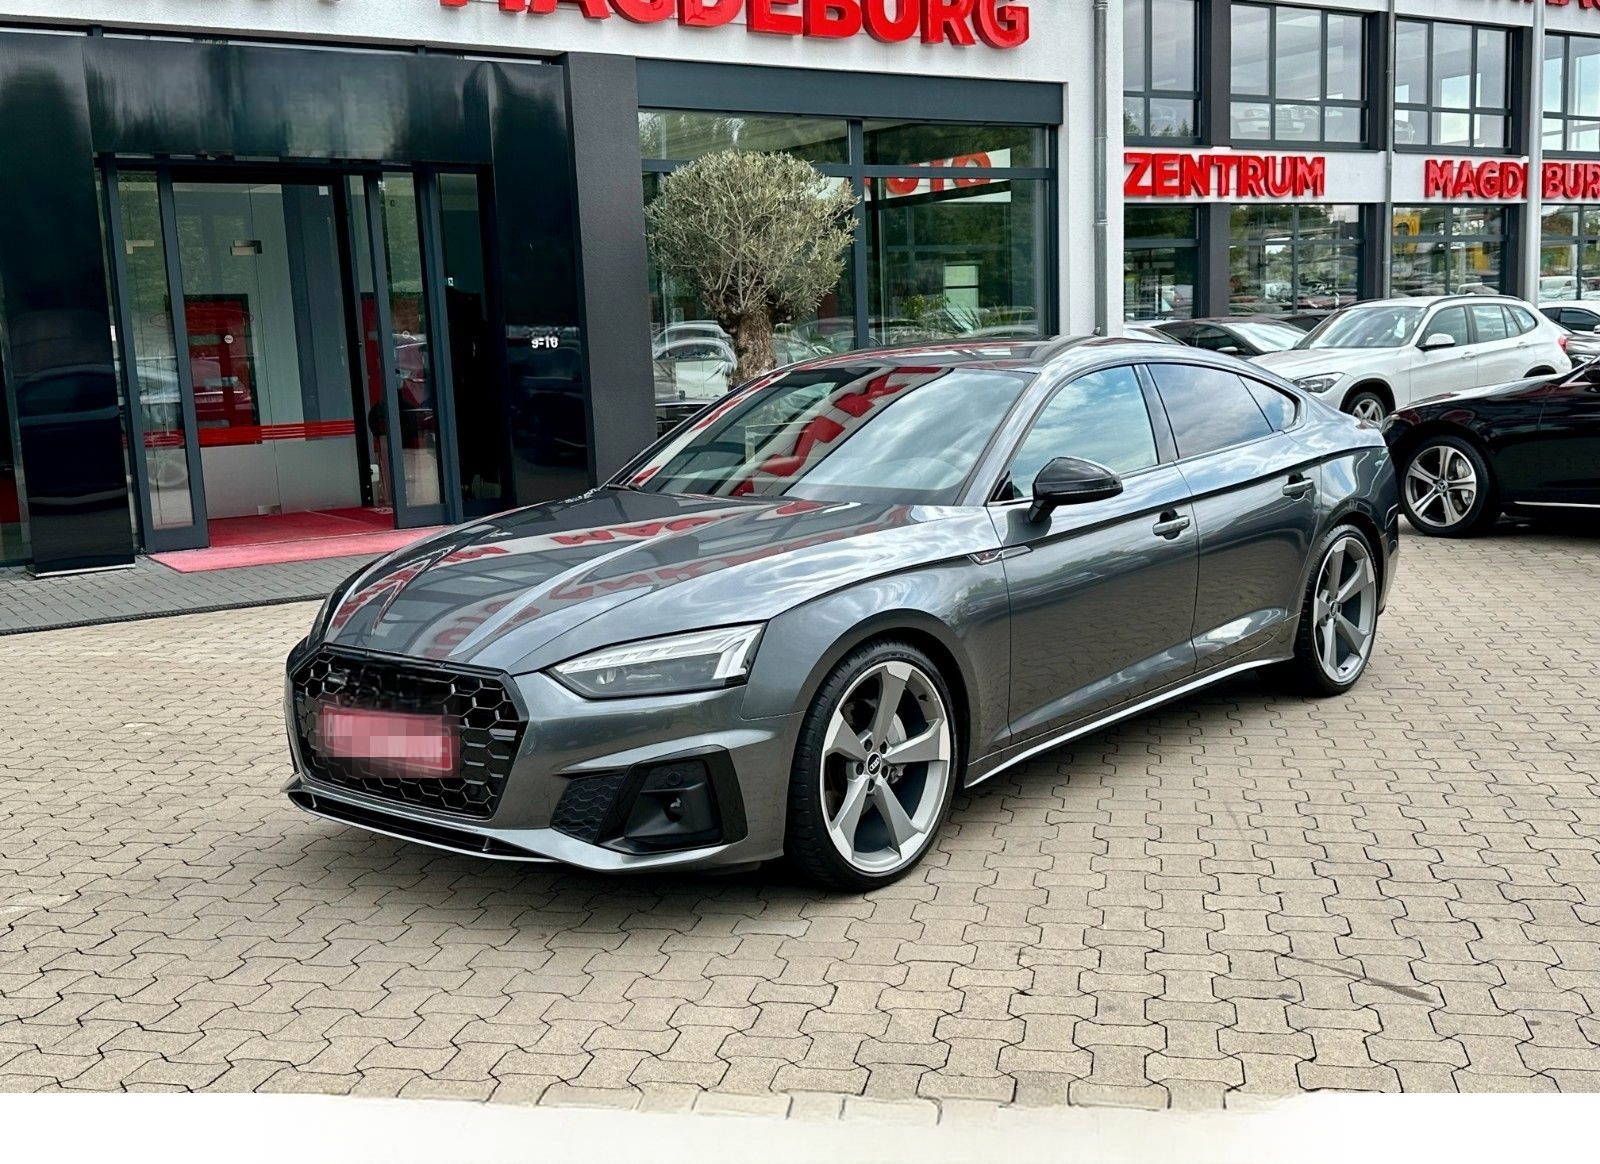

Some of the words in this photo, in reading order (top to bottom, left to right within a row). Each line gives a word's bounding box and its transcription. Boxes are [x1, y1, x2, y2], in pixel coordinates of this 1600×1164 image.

[440, 0, 1031, 49] EBURG
[1124, 152, 1326, 198] ZENTRUM
[1424, 159, 1600, 199] MAGDBUR
